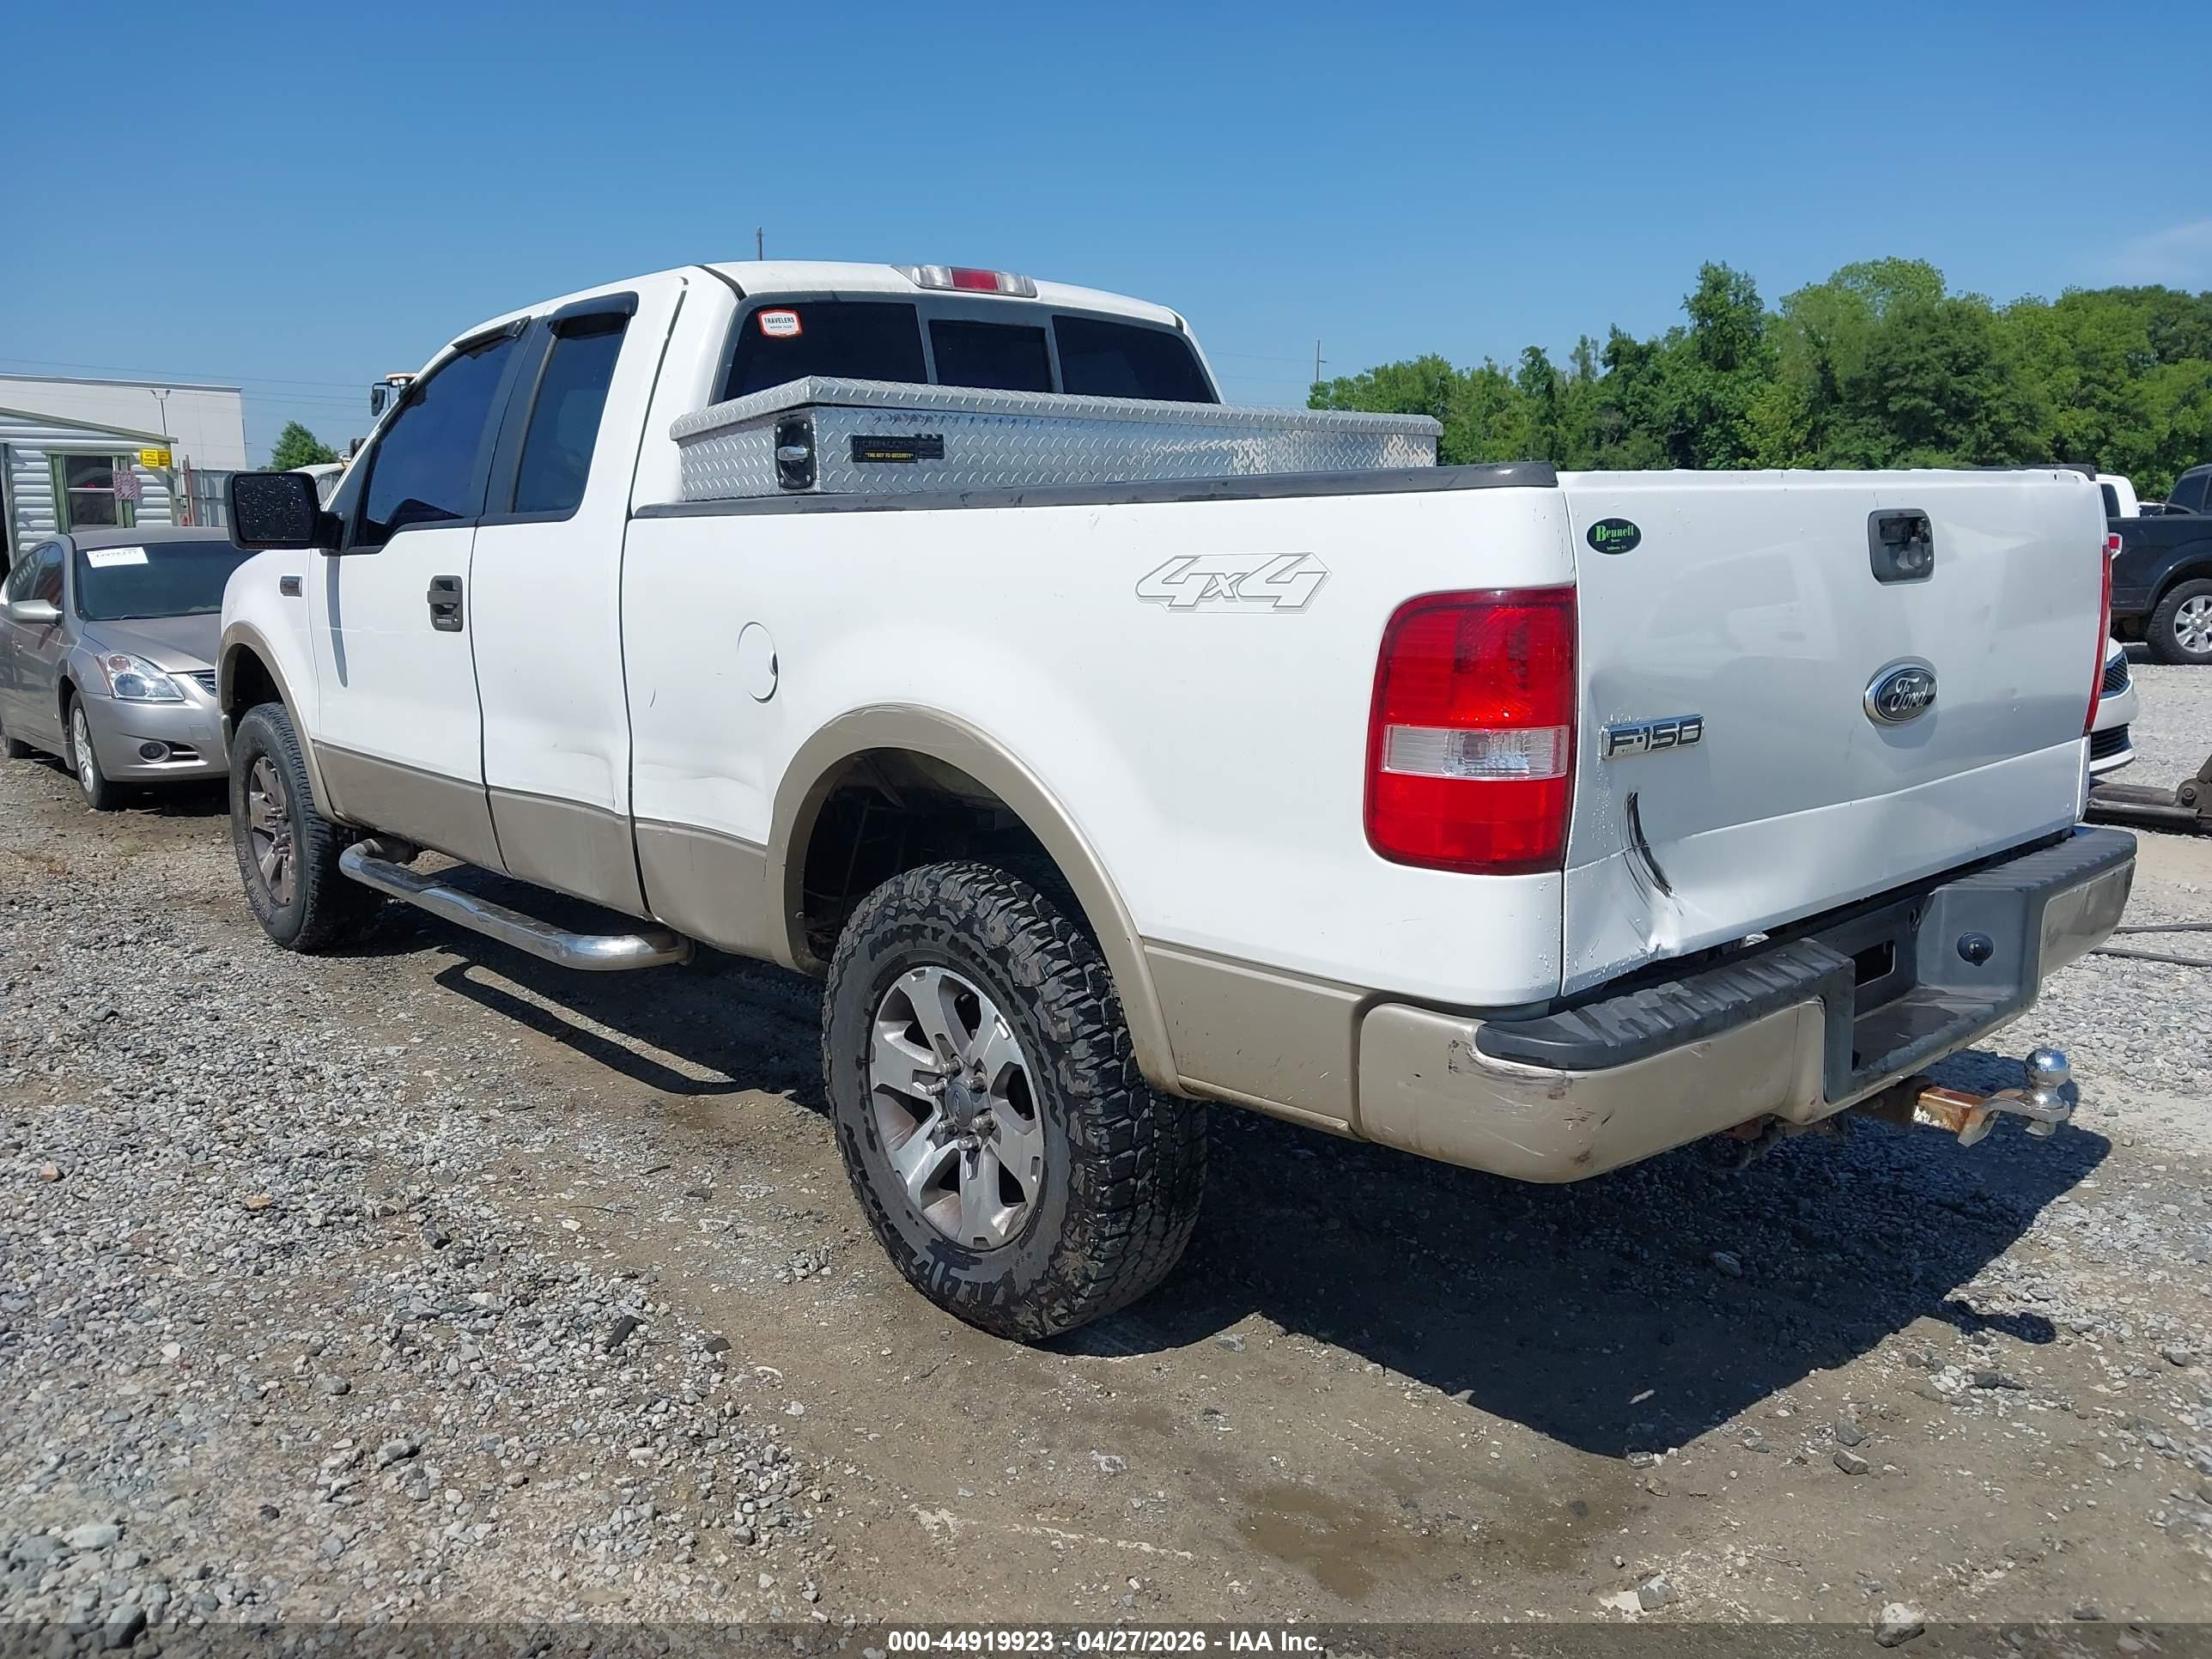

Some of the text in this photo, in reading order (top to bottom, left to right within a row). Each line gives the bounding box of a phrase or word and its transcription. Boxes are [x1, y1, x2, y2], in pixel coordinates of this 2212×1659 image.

[1595, 525, 1634, 542] Bennett
[1890, 676, 1929, 712] Ford
[1607, 718, 1702, 757] F-150
